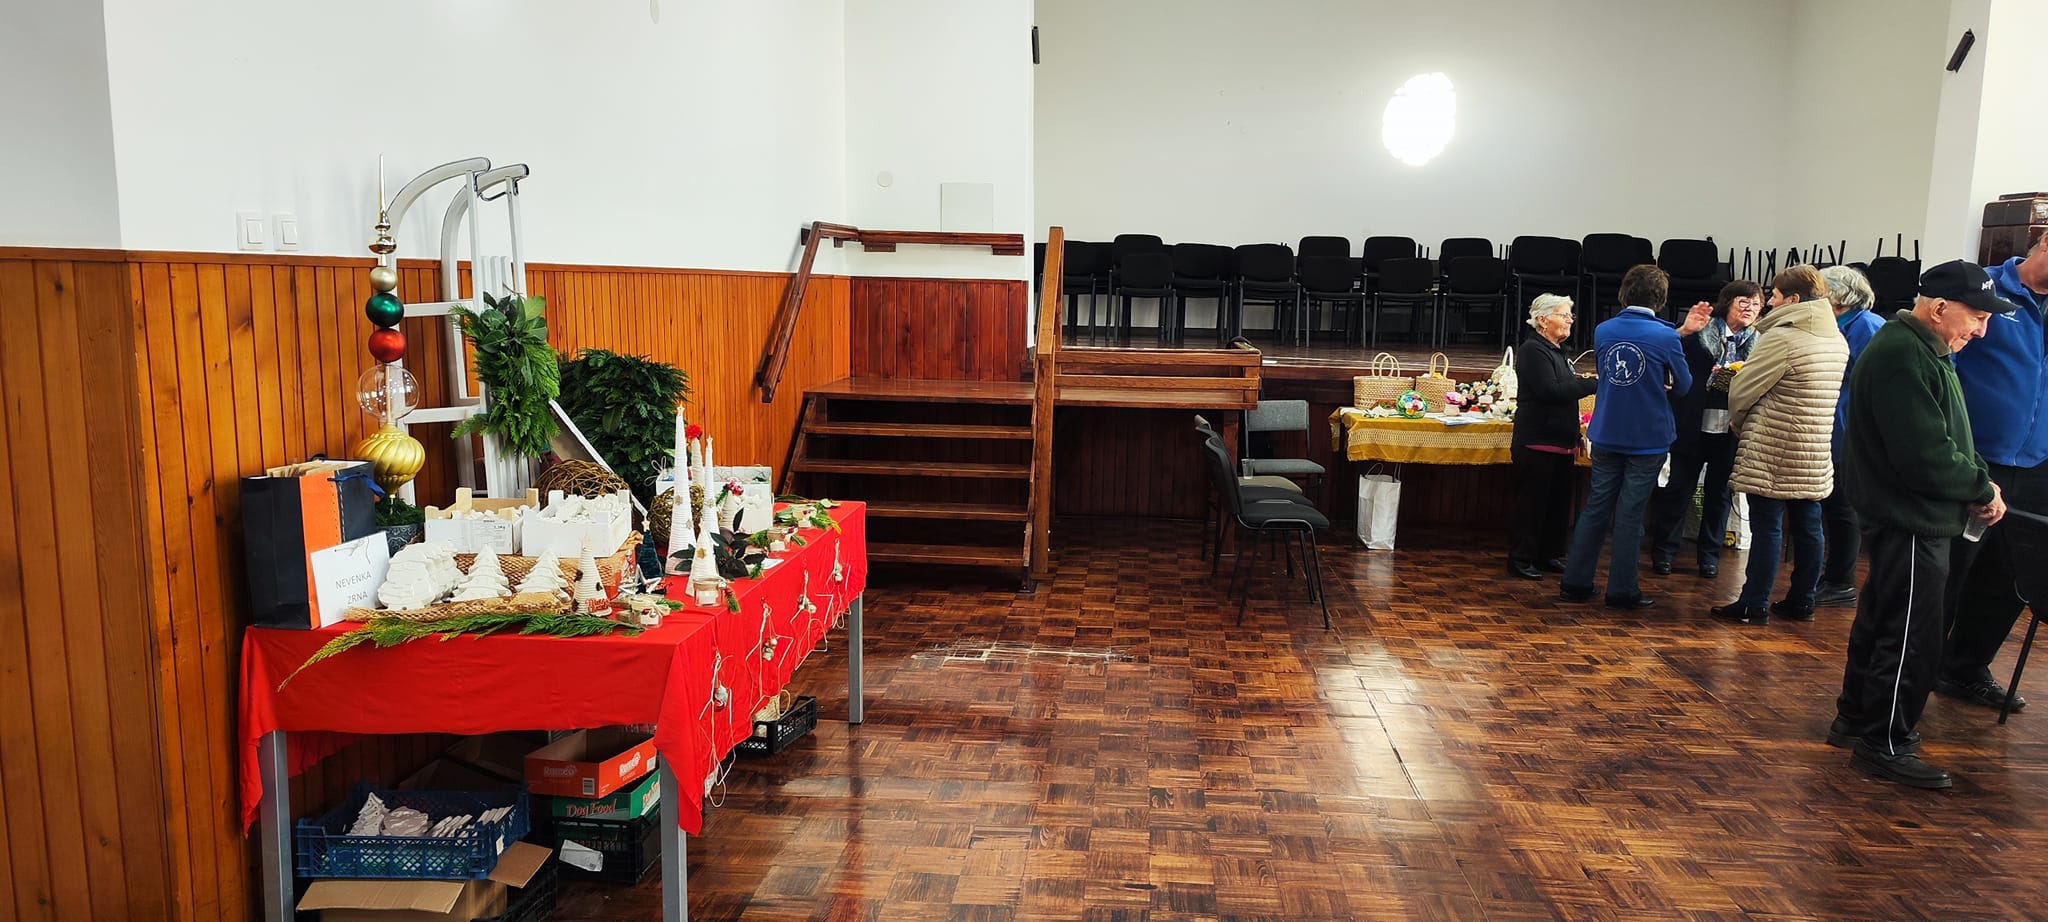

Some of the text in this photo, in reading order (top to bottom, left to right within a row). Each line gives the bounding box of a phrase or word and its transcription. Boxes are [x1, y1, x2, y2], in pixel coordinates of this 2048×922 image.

[335, 571, 372, 590] NEVENKA
[347, 591, 368, 605] ZRNA
[565, 798, 618, 817] Dog Food
